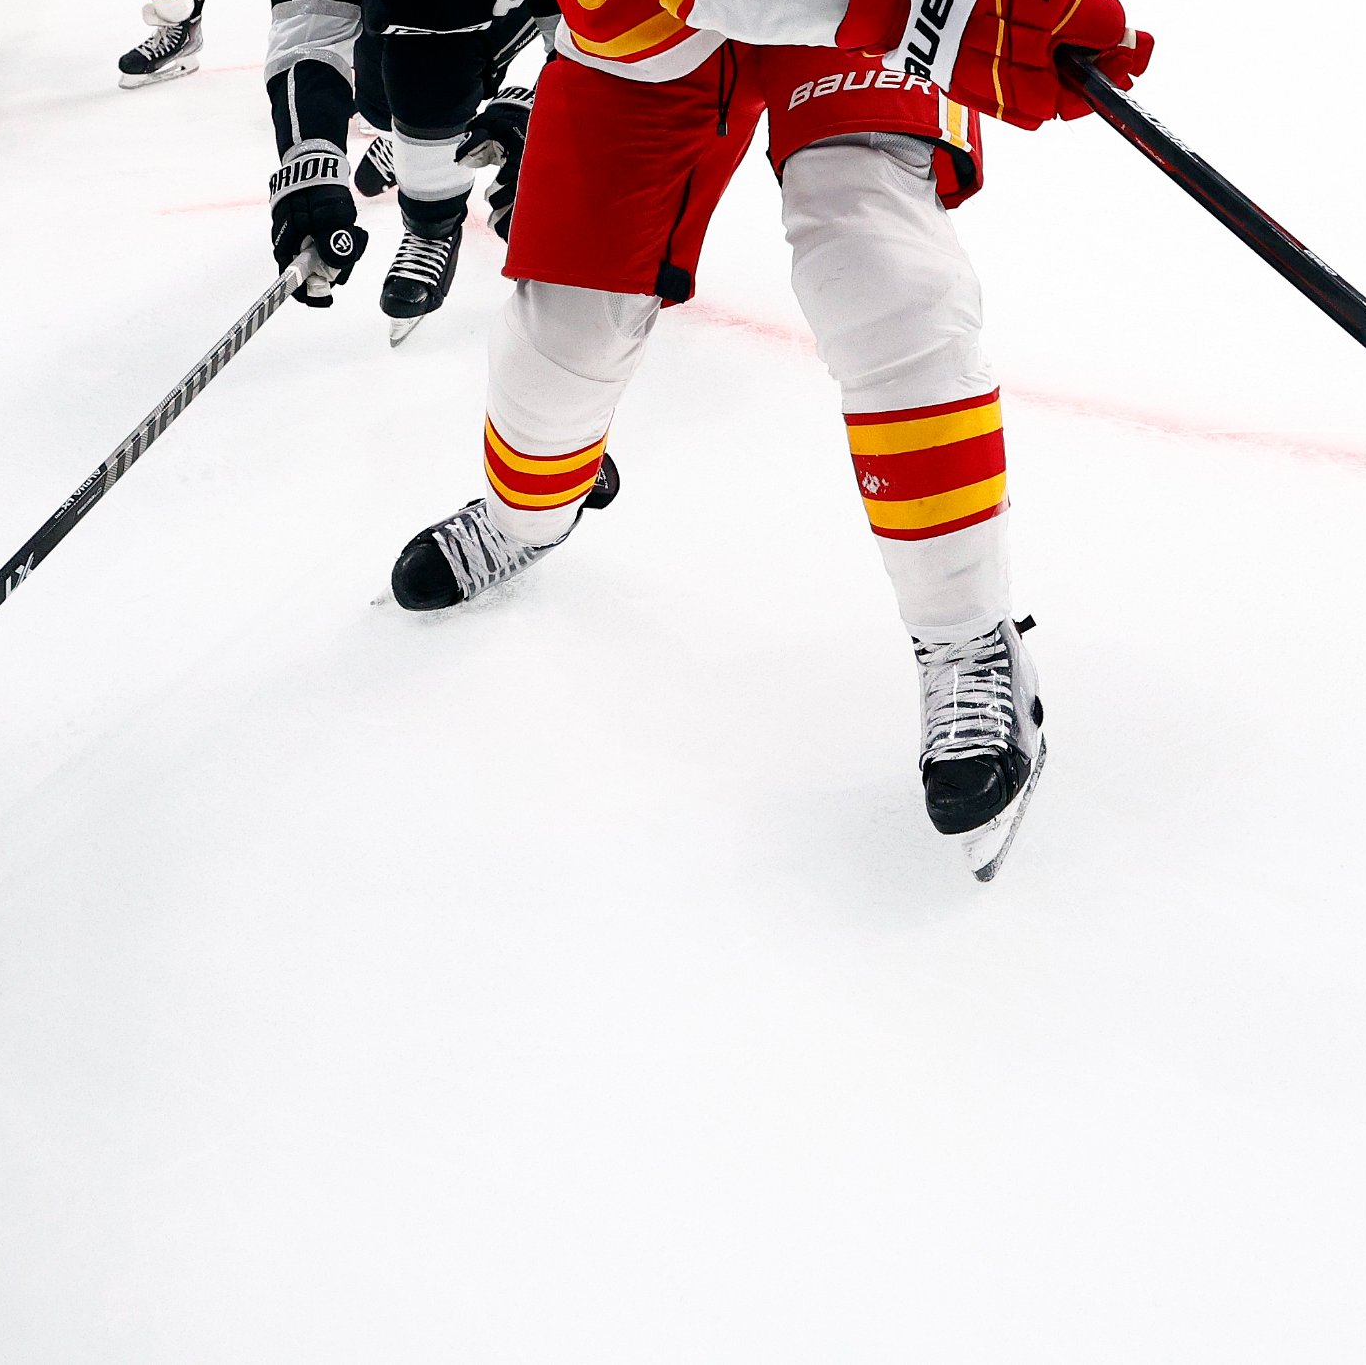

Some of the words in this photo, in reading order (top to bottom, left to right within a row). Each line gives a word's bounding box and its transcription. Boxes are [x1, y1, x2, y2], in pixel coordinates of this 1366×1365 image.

[788, 70, 933, 112] BAUER
[75, 468, 103, 498] ALPHA
[4, 551, 34, 600] LX
